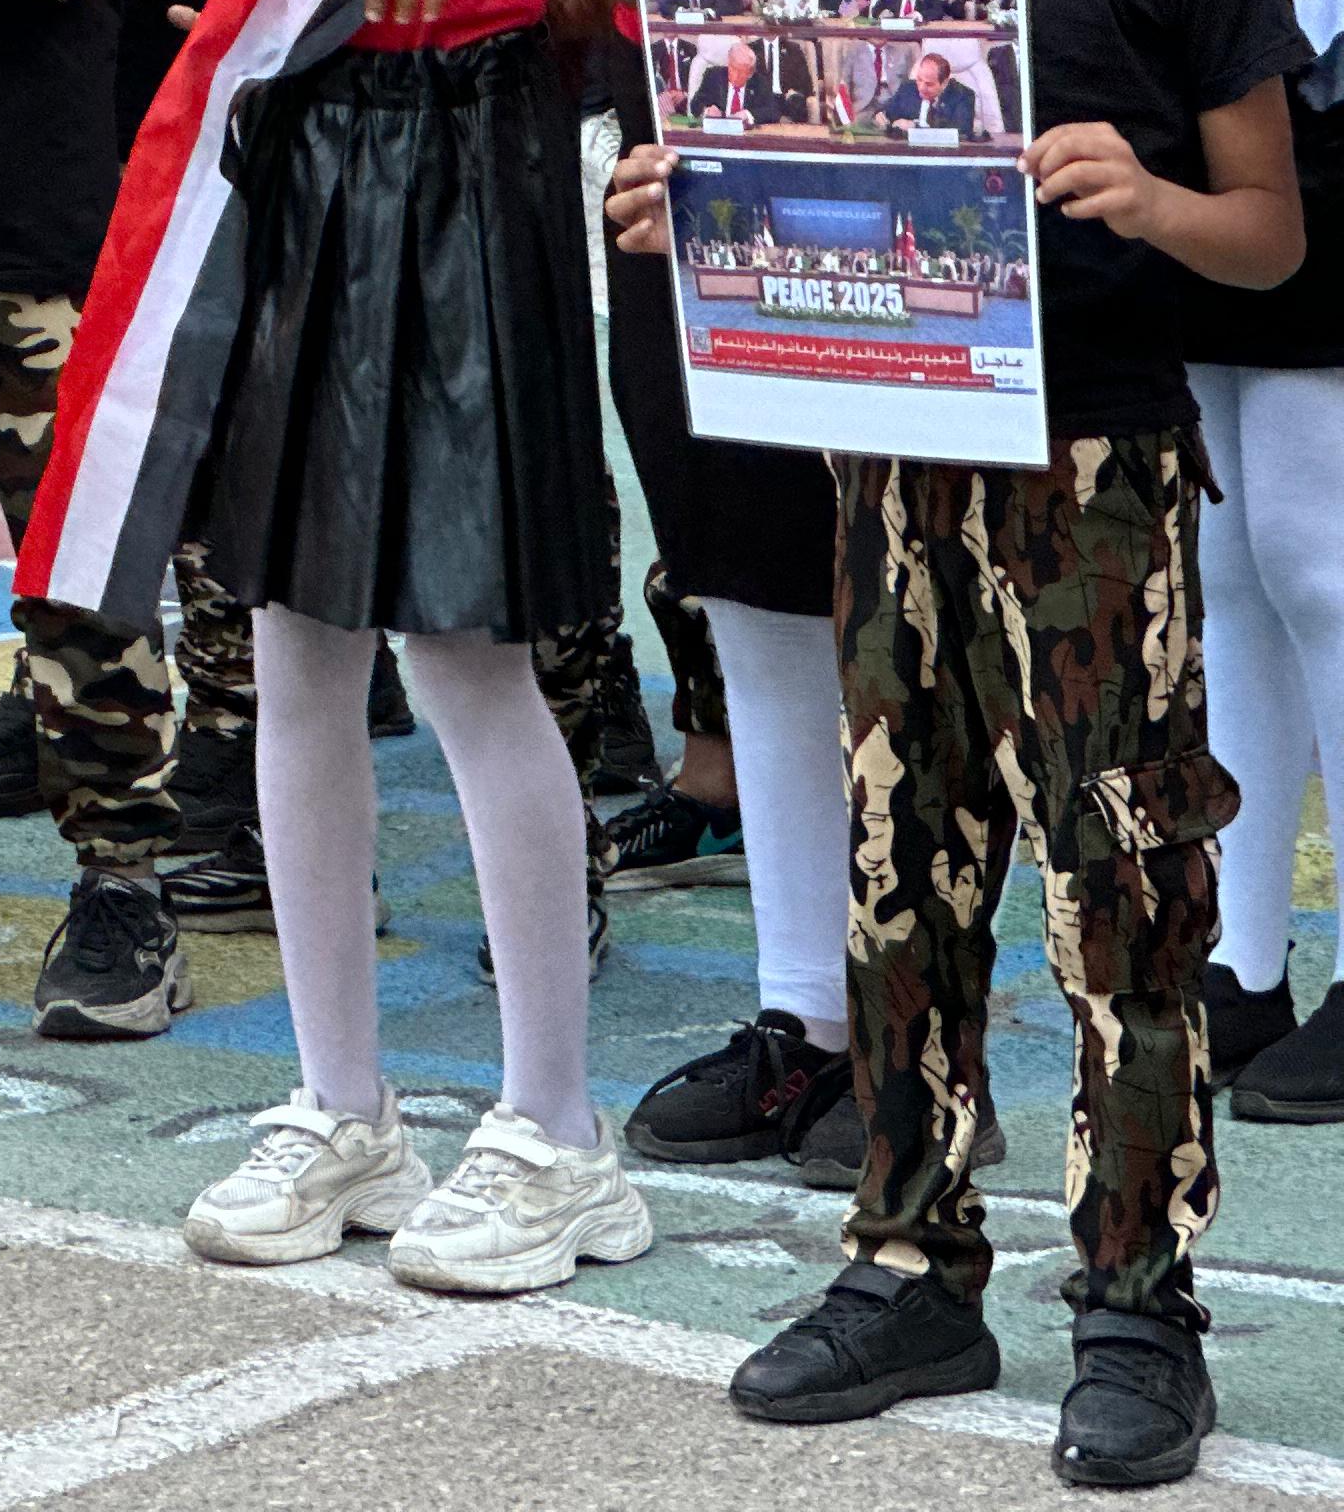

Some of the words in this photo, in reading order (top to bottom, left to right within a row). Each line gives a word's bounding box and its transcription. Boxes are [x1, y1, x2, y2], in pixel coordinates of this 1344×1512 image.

[762, 275, 836, 313] PEACE
[838, 280, 904, 317] 2025
[975, 351, 1024, 370] عاجل
